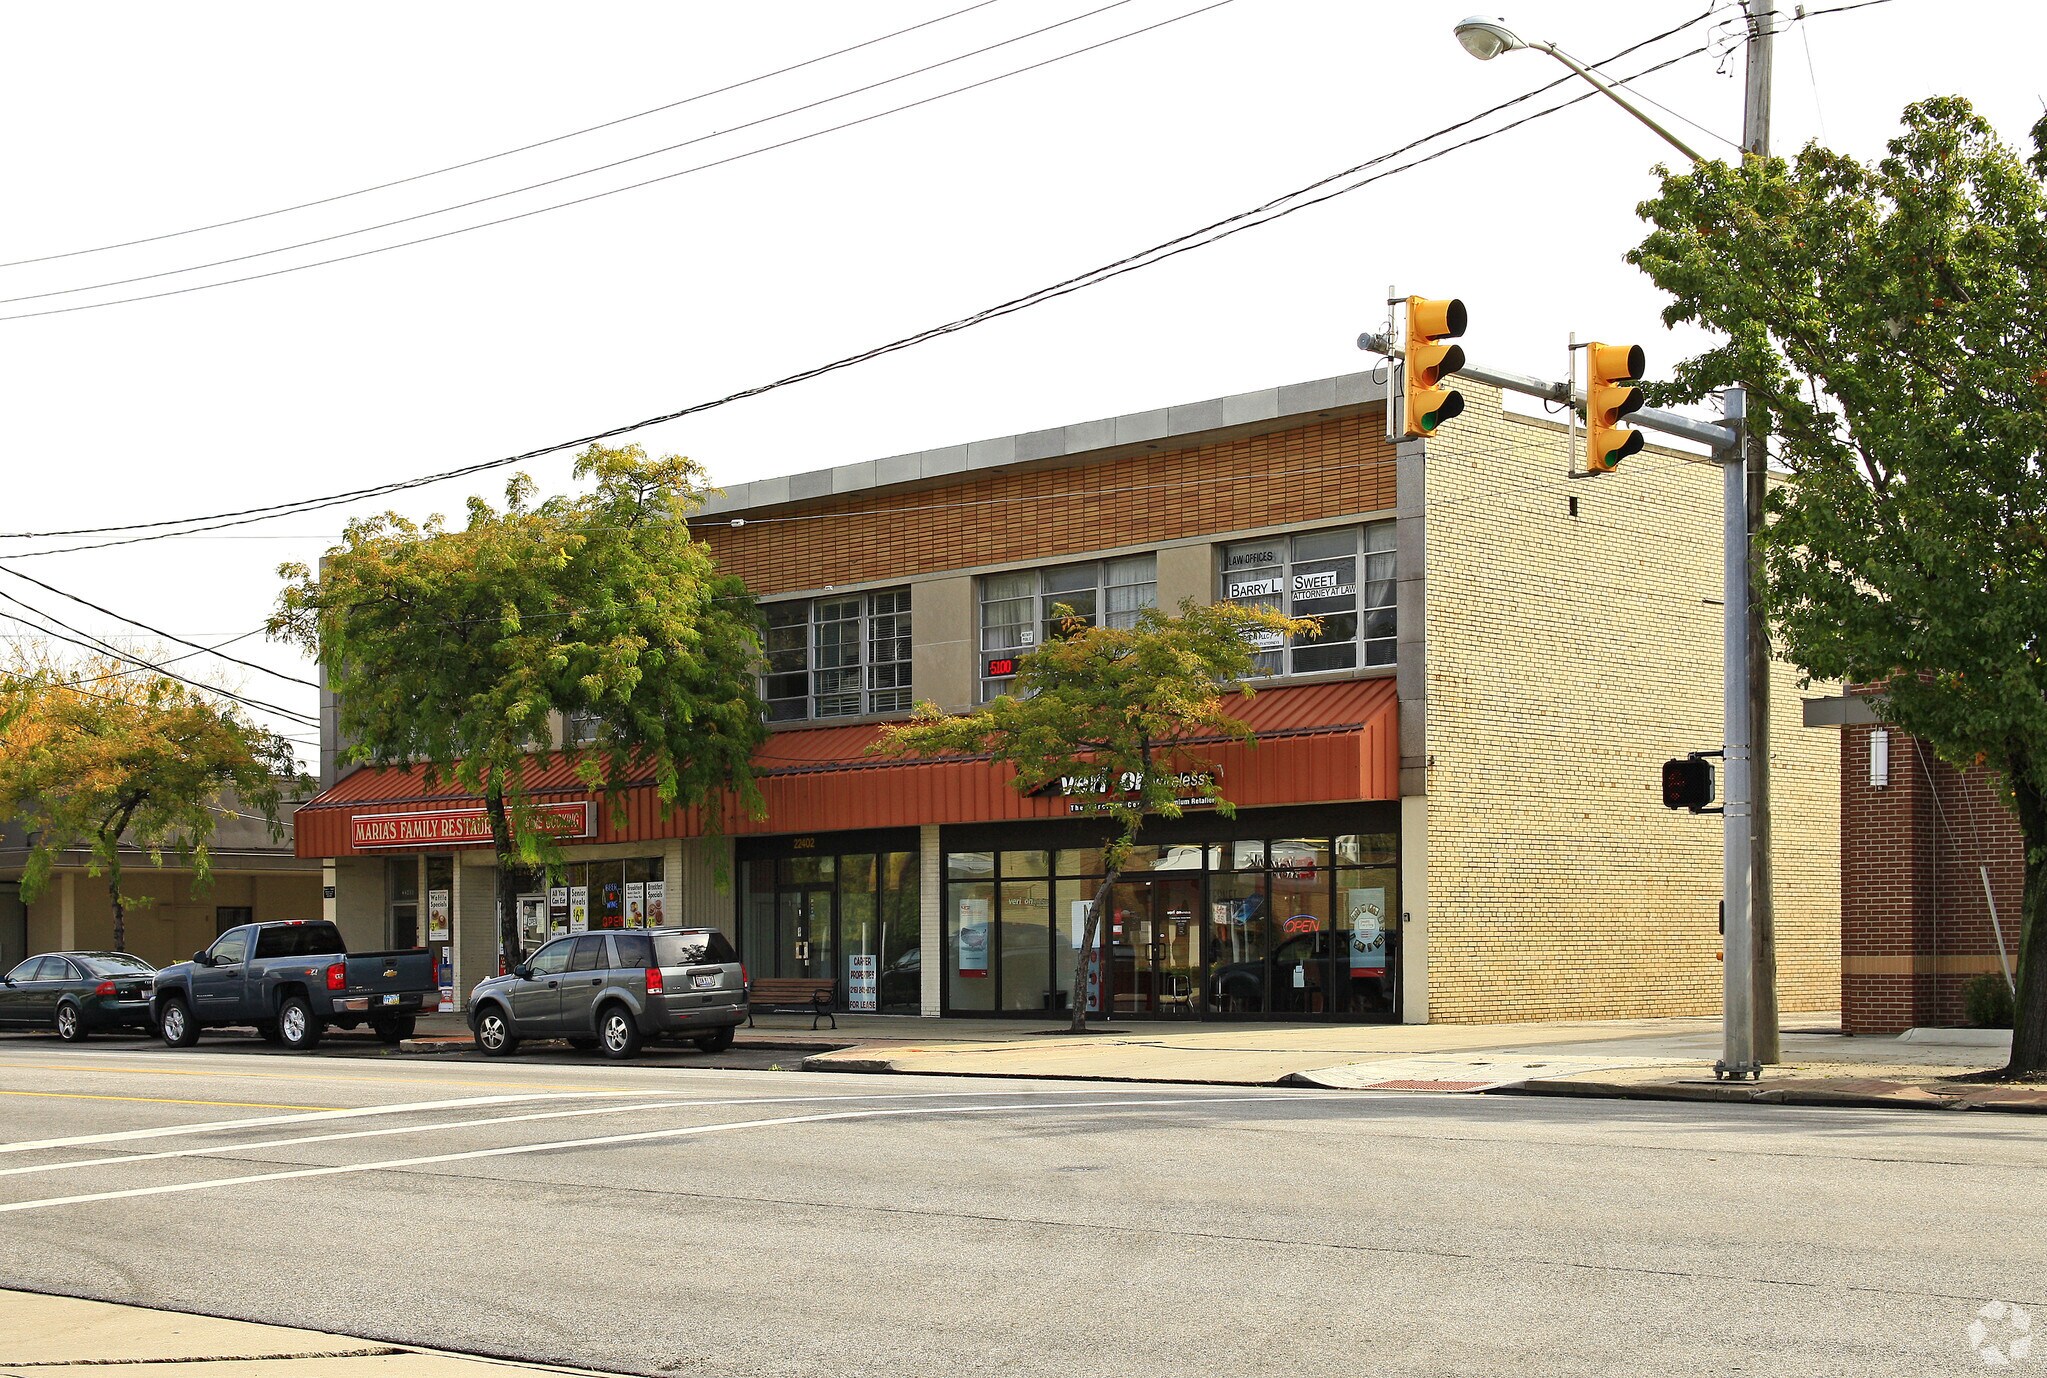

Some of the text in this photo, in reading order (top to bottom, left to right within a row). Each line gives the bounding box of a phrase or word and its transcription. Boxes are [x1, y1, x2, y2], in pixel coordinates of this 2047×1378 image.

[1228, 551, 1273, 566] LAW OFFICES
[1293, 584, 1356, 601] ATTORNEY AT LAW
[1069, 803, 1084, 812] The
[355, 821, 397, 841] MARIA'S
[400, 819, 438, 839] FAMILY
[571, 888, 586, 897] Senior
[571, 898, 586, 906] Meals
[1008, 897, 1033, 905] verion
[602, 915, 624, 928] OPEN
[1285, 919, 1321, 933] OPEN
[850, 1000, 876, 1009] FOR LEASE
